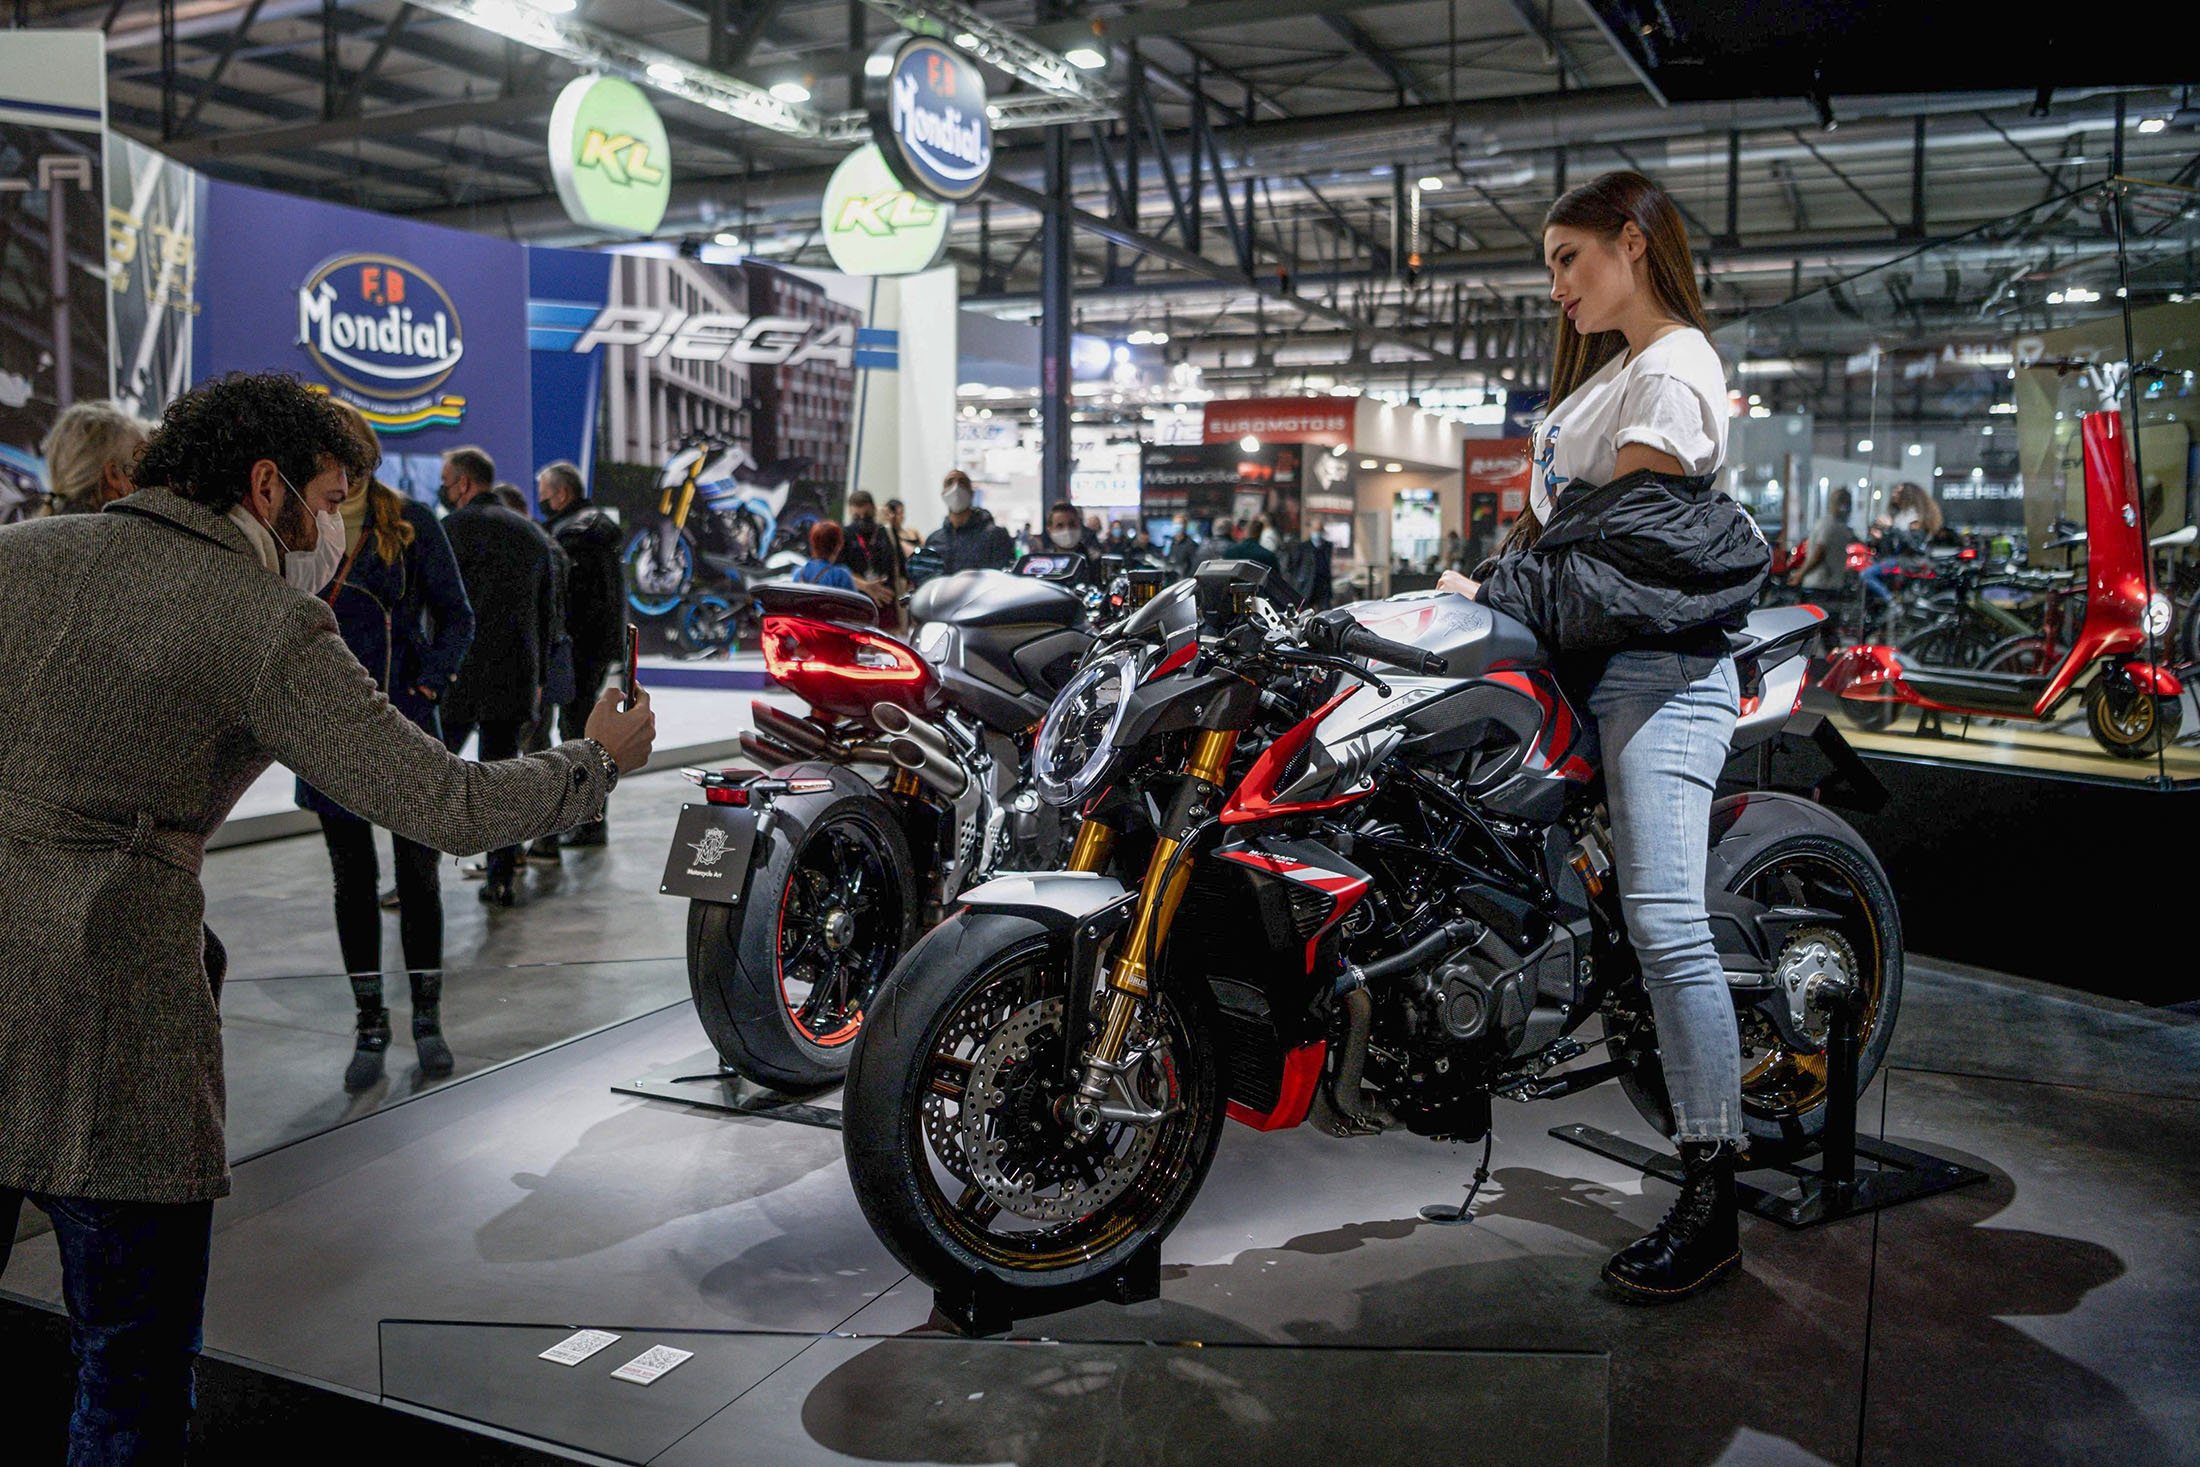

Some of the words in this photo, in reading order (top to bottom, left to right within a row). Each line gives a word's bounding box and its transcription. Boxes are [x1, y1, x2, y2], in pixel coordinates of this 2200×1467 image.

[893, 72, 990, 176] Mondial
[578, 129, 664, 187] KL
[833, 191, 937, 236] KL
[299, 280, 462, 374] Mondial
[574, 307, 855, 369] PIEGA
[686, 868, 713, 878] Motorcycle
